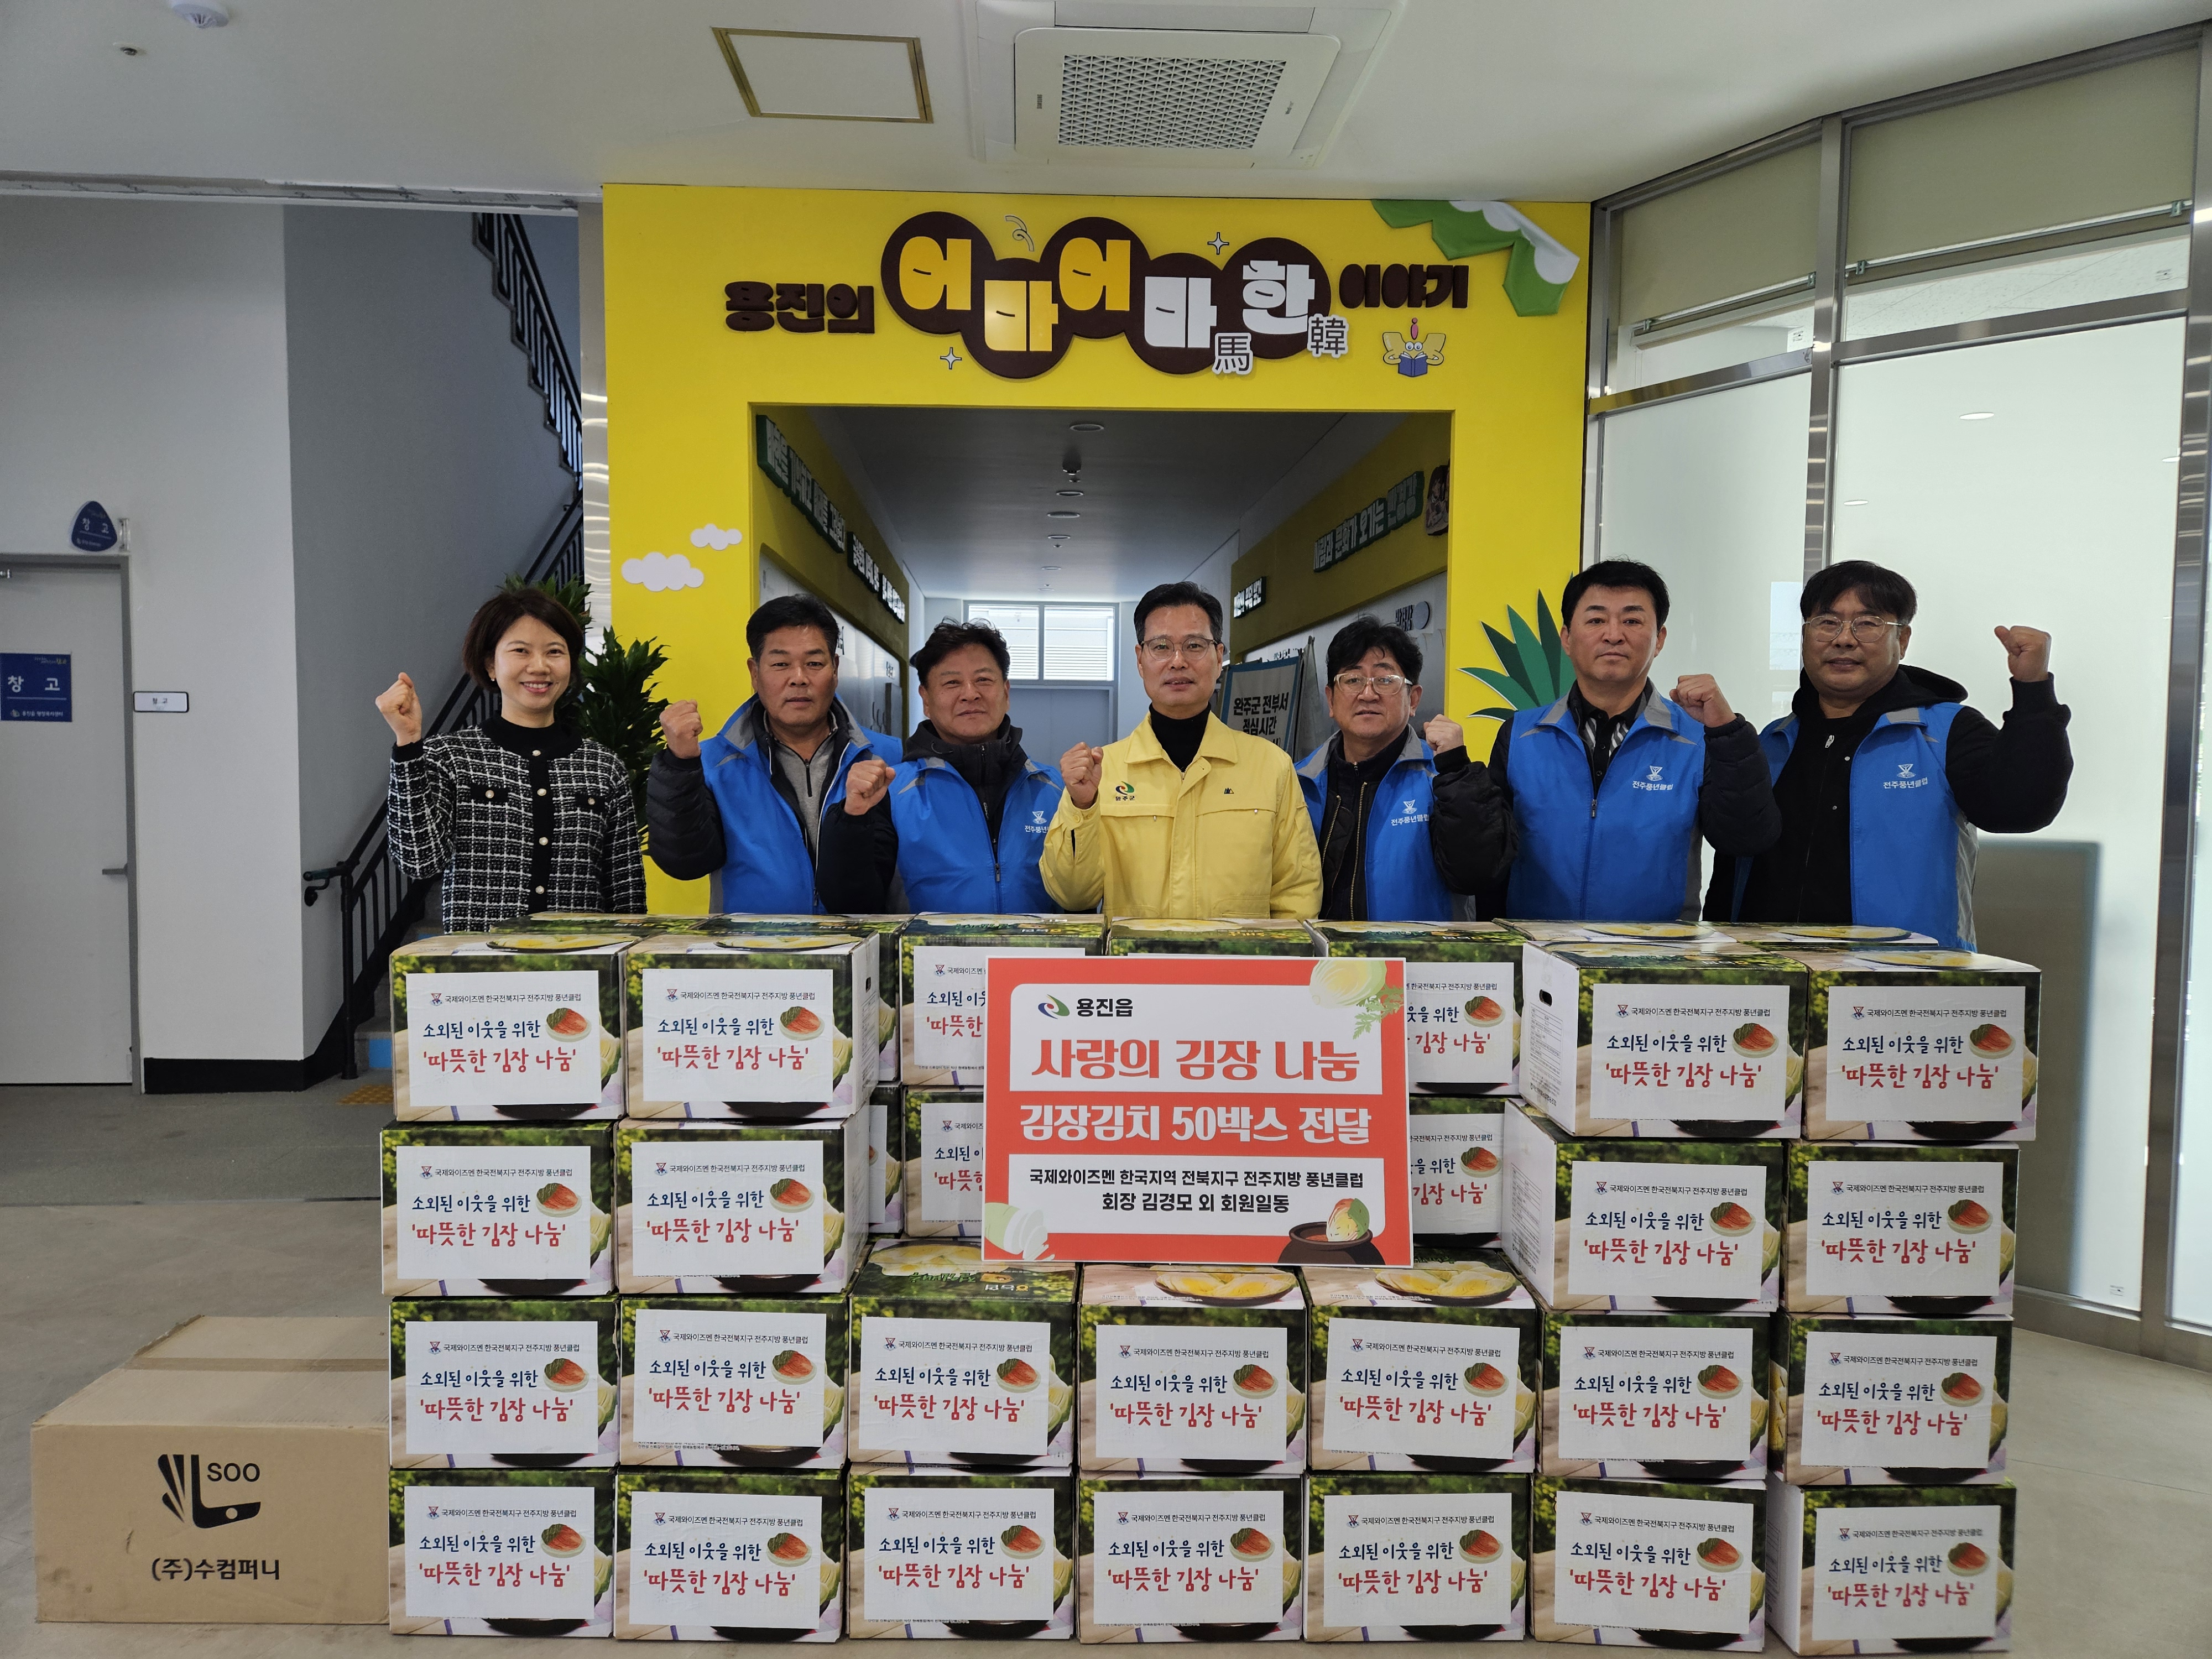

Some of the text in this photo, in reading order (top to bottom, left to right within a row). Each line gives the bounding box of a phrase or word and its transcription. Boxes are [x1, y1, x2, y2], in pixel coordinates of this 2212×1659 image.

[725, 281, 875, 333] 용진의
[1339, 263, 1469, 310] 이야기
[1216, 335, 1251, 373] 馬
[1359, 499, 1384, 545] 오가는
[1233, 692, 1289, 716] 완주군 전부서
[1243, 716, 1277, 736] 점심시간
[1632, 780, 1673, 791] 전주풍년클럽
[1883, 777, 1928, 789] 전주풍년클럽
[1391, 814, 1430, 826] 전주풍년클럽
[927, 990, 985, 1006] 소외된 이웃
[1077, 999, 1133, 1016] 용진읍
[1407, 1006, 1459, 1022] 웃을 위한
[423, 1020, 541, 1039] 소외된 이웃을 위한
[927, 1015, 983, 1037] '따뜻한
[1416, 1031, 1490, 1054] 김장 나눔'
[1843, 1035, 1964, 1053] 소외된 이웃을 위한
[424, 1047, 575, 1072] '따뜻한 김장 나눔'
[1032, 1040, 1359, 1082] 사랑의 김장 나눔
[1842, 1063, 1998, 1089] '따뜻한 김장 나눔'
[1021, 1105, 1371, 1144] 김장김치 50박스 전달
[935, 1146, 970, 1161] 소외된
[1430, 1158, 1455, 1174] 위한
[1030, 1170, 1363, 1188] 국제와이즈멘 한국지역 전북지구 전주지방 풍년클럽
[647, 1190, 764, 1208] 소외된 이웃을 위한
[1413, 1182, 1487, 1205] 김장 나눔'
[1651, 1186, 1691, 1194] 한국전북지구
[1103, 1193, 1289, 1213] 회장 김경모 외 회원일동
[647, 1218, 798, 1243] '따뜻한 김장 나눔'
[1585, 1211, 1704, 1231] 소외된 이웃을 위한
[1585, 1238, 1738, 1266] '따뜻한 김장 나눔'
[714, 1334, 753, 1343] 한국전북지구
[650, 1359, 766, 1379] 소외된 이웃을 위한
[649, 1387, 800, 1414] '따뜻한 김장 나눔'
[207, 1463, 260, 1482] SOO
[1595, 1516, 1734, 1532] 국제와이즈멘 한국전북지구 전주지방 풍년클럽
[879, 1536, 995, 1554] 소외된 이웃을 위한
[1571, 1542, 1691, 1566] 소외된 이웃을 위한
[152, 1558, 279, 1581] (주)수컴퍼니
[879, 1564, 1029, 1589] '따뜻한 김장 나눔'
[1570, 1569, 1725, 1601] '따뜻한 김장 나눔'
